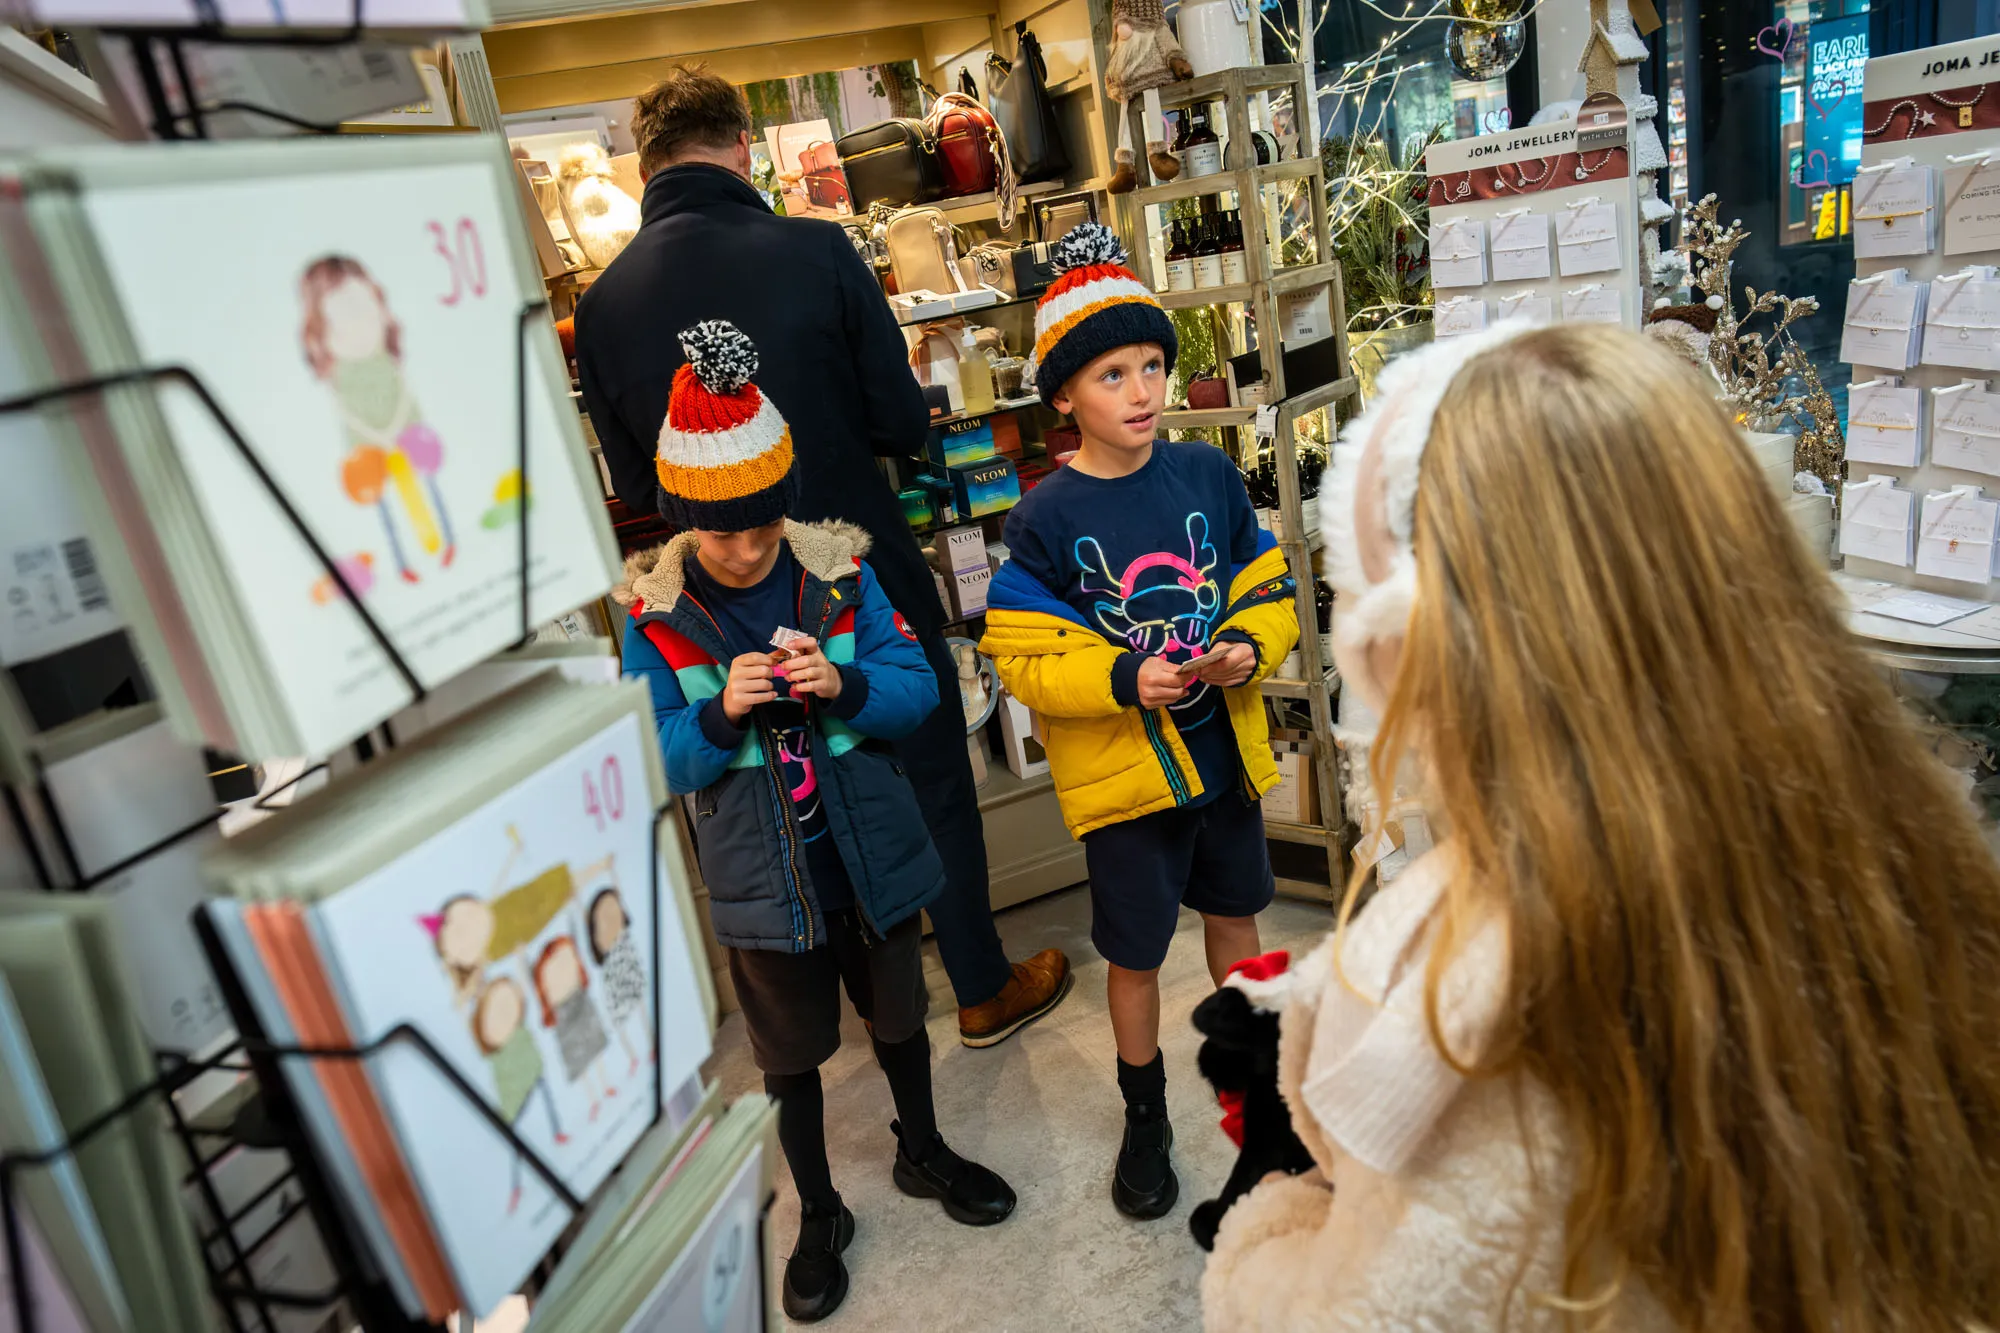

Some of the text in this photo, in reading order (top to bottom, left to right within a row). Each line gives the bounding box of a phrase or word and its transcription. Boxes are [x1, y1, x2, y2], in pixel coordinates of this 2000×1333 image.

[1813, 61, 1846, 76] BLACK
[1923, 56, 1971, 76] JOMA
[1581, 128, 1624, 142] WITH LOVE
[1468, 129, 1577, 158] JOMA JEWELLERY
[1960, 190, 1990, 200] COMING
[425, 216, 488, 307] 30
[949, 419, 981, 434] NEOM
[974, 467, 1008, 484] NEOM
[951, 530, 981, 545] NEOM
[959, 571, 990, 585] NEOM
[582, 754, 624, 834] 40
